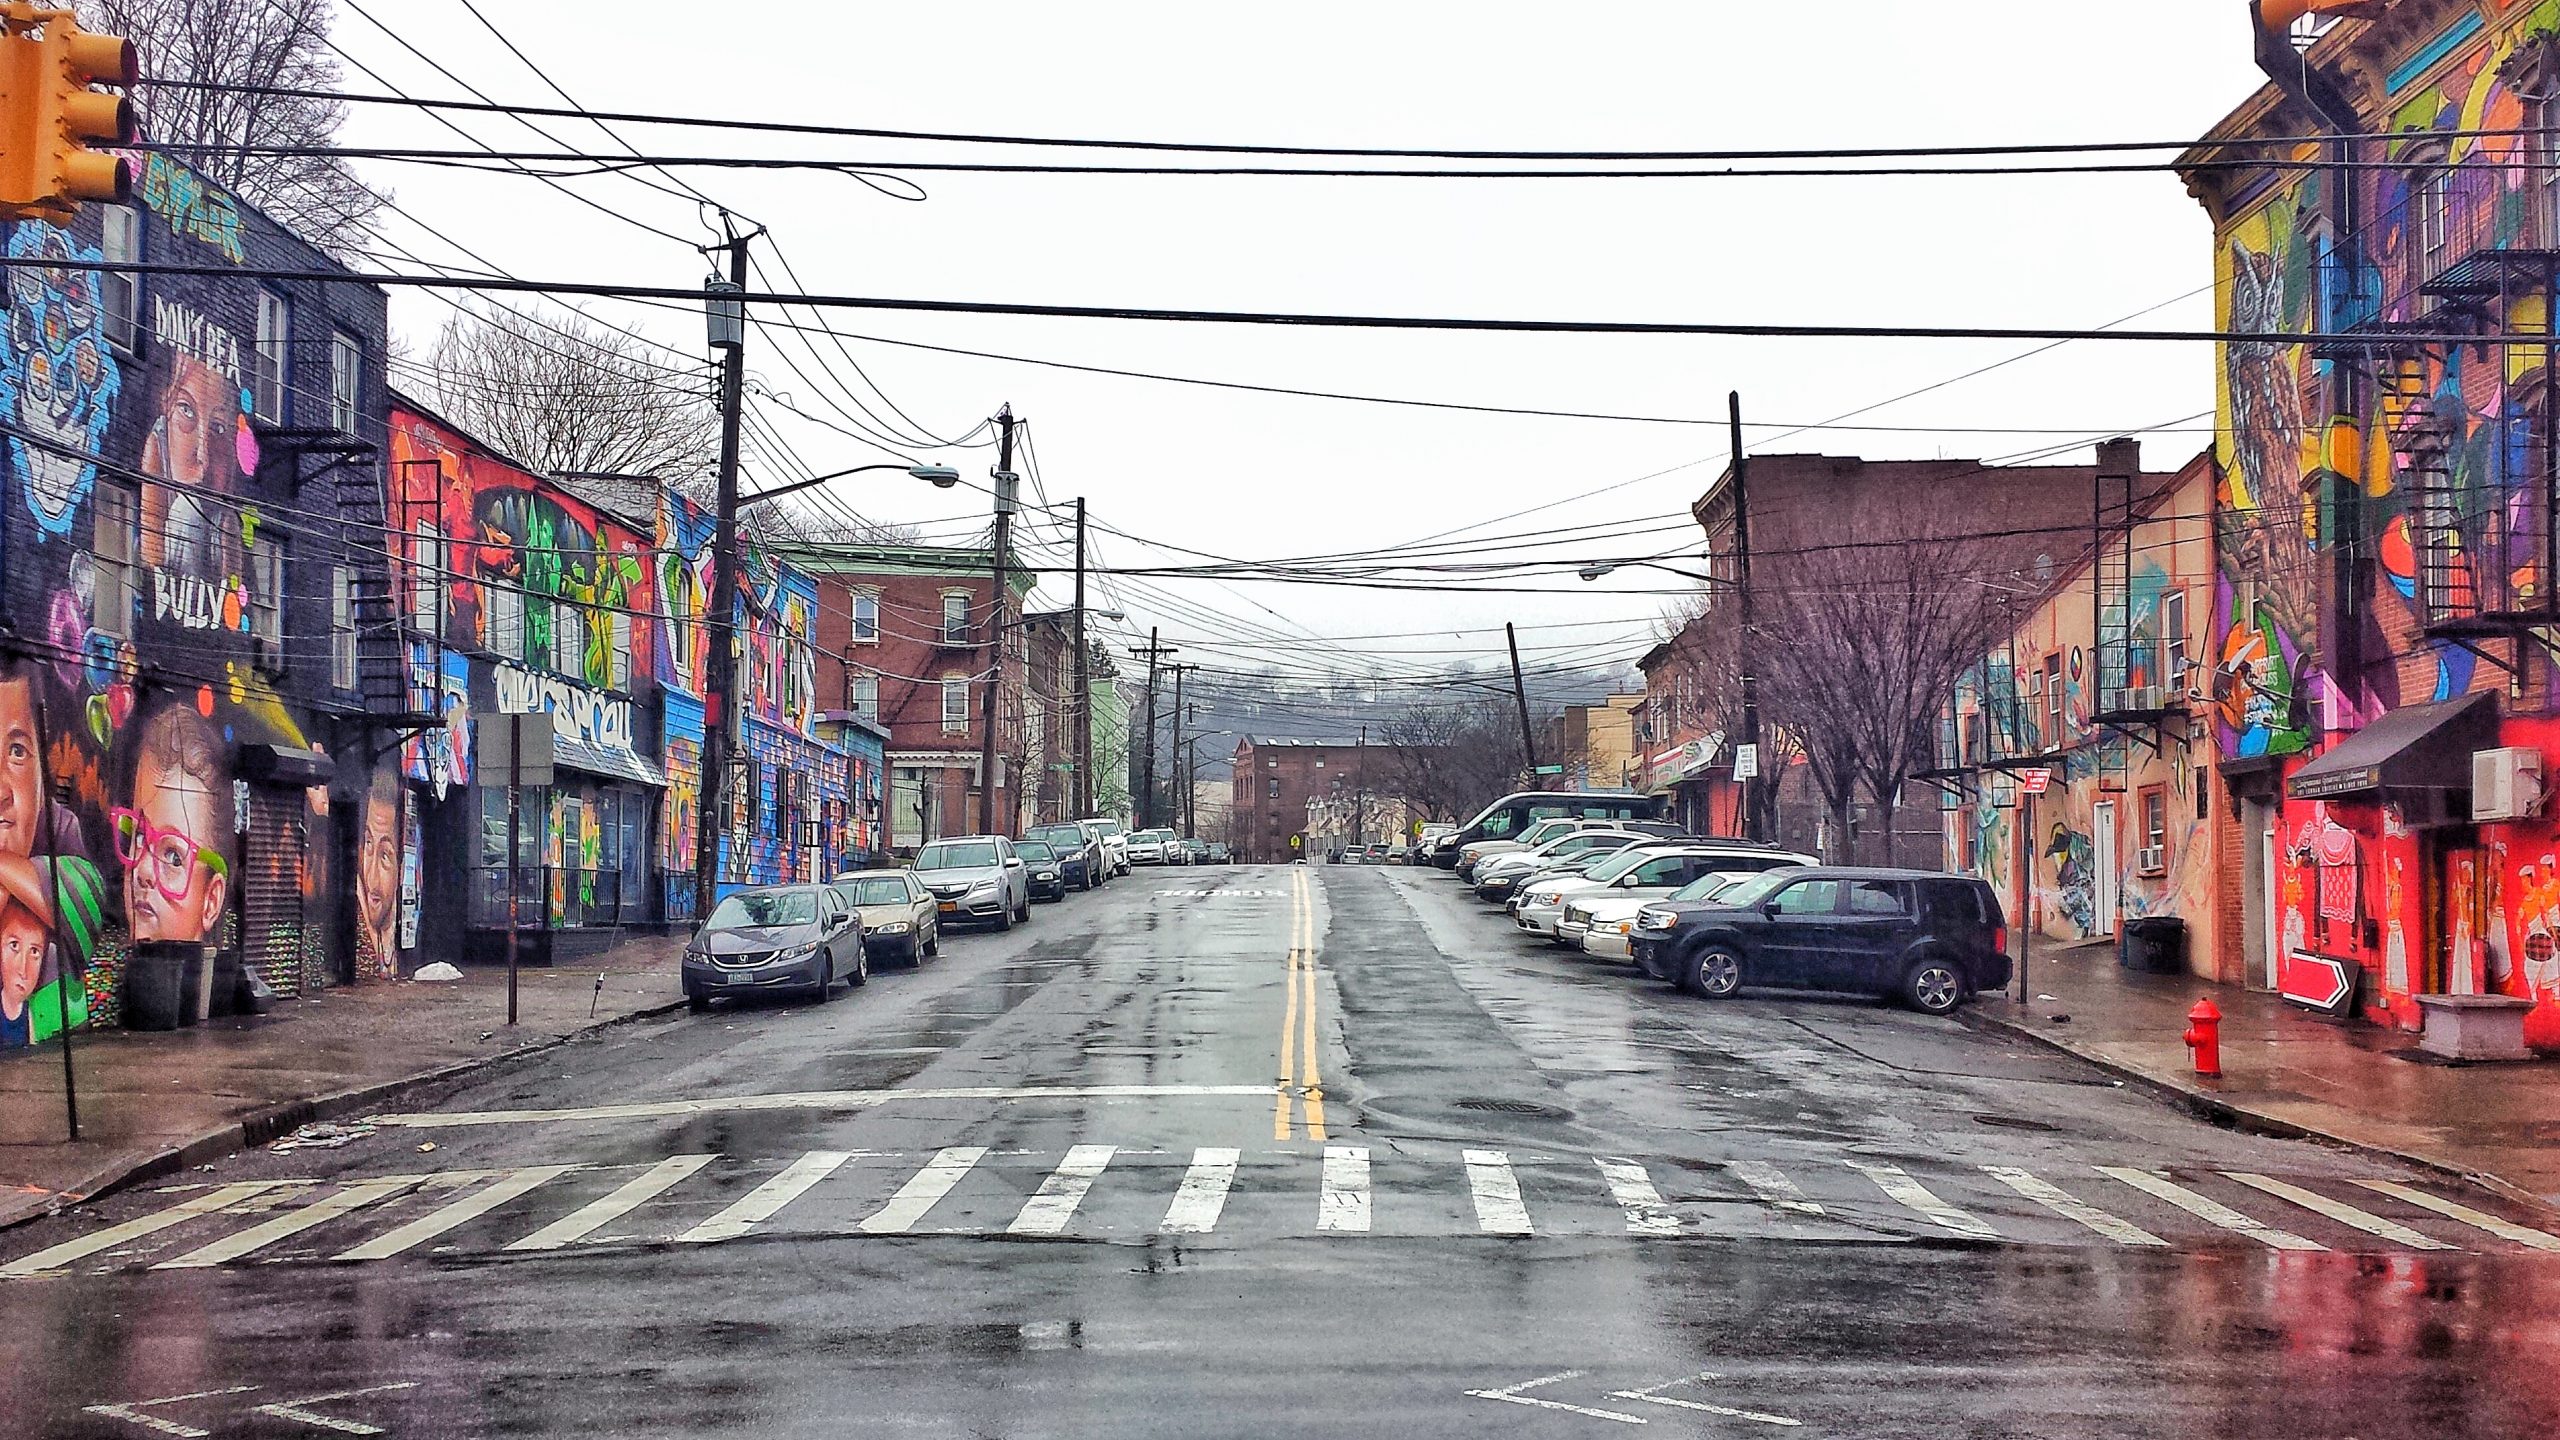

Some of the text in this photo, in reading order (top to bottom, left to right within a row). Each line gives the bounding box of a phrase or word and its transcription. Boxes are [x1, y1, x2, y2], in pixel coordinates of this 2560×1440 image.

[155, 293, 241, 389] DON'T BE A
[154, 565, 227, 630] BULLY
